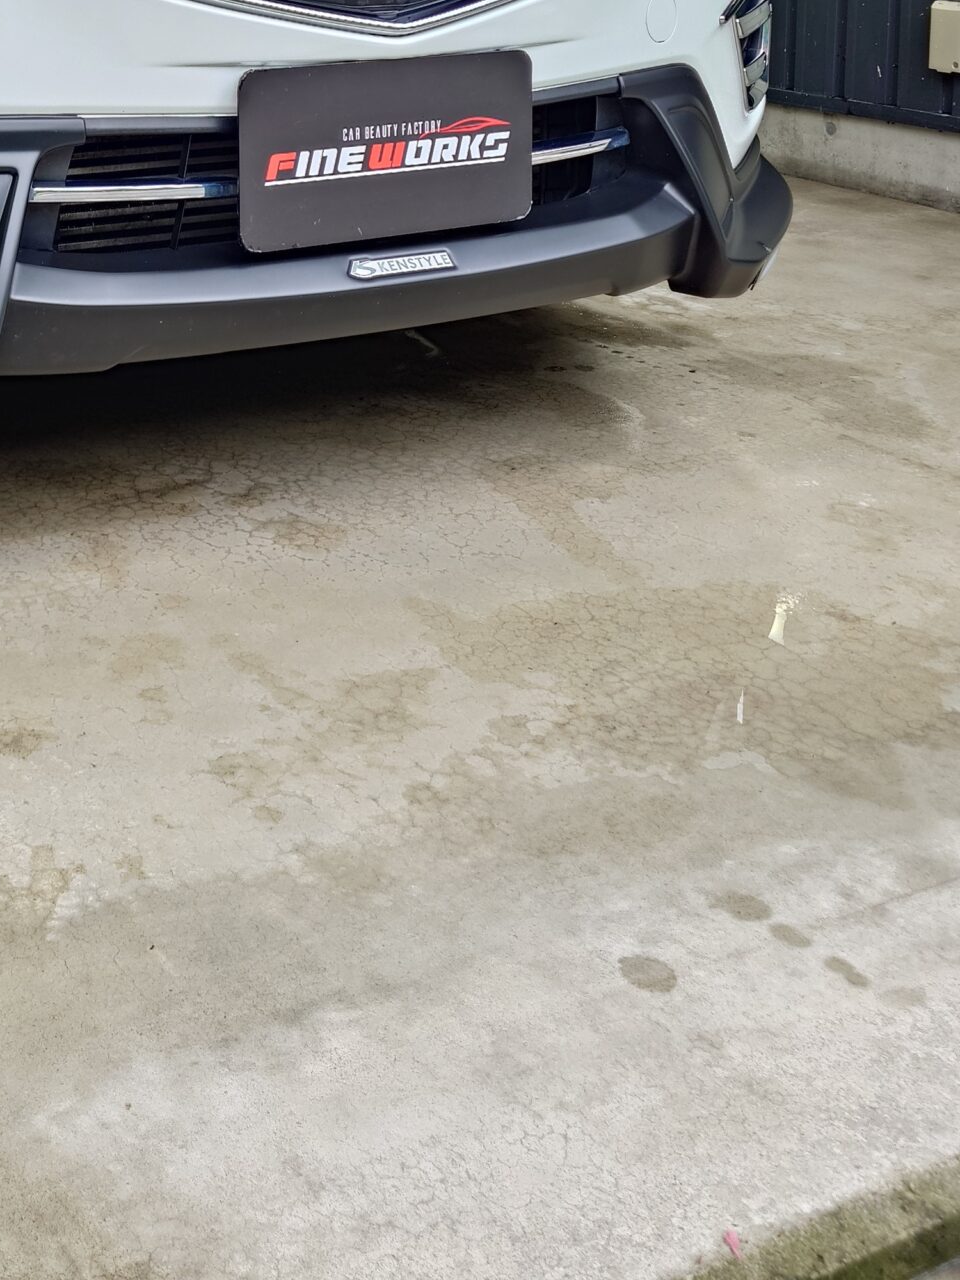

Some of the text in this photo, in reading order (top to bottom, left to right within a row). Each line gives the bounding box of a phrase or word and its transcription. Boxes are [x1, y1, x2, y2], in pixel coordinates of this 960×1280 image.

[342, 119, 442, 142] CAR BEAUTY FACTORY
[377, 254, 451, 273] KENSTYLE
